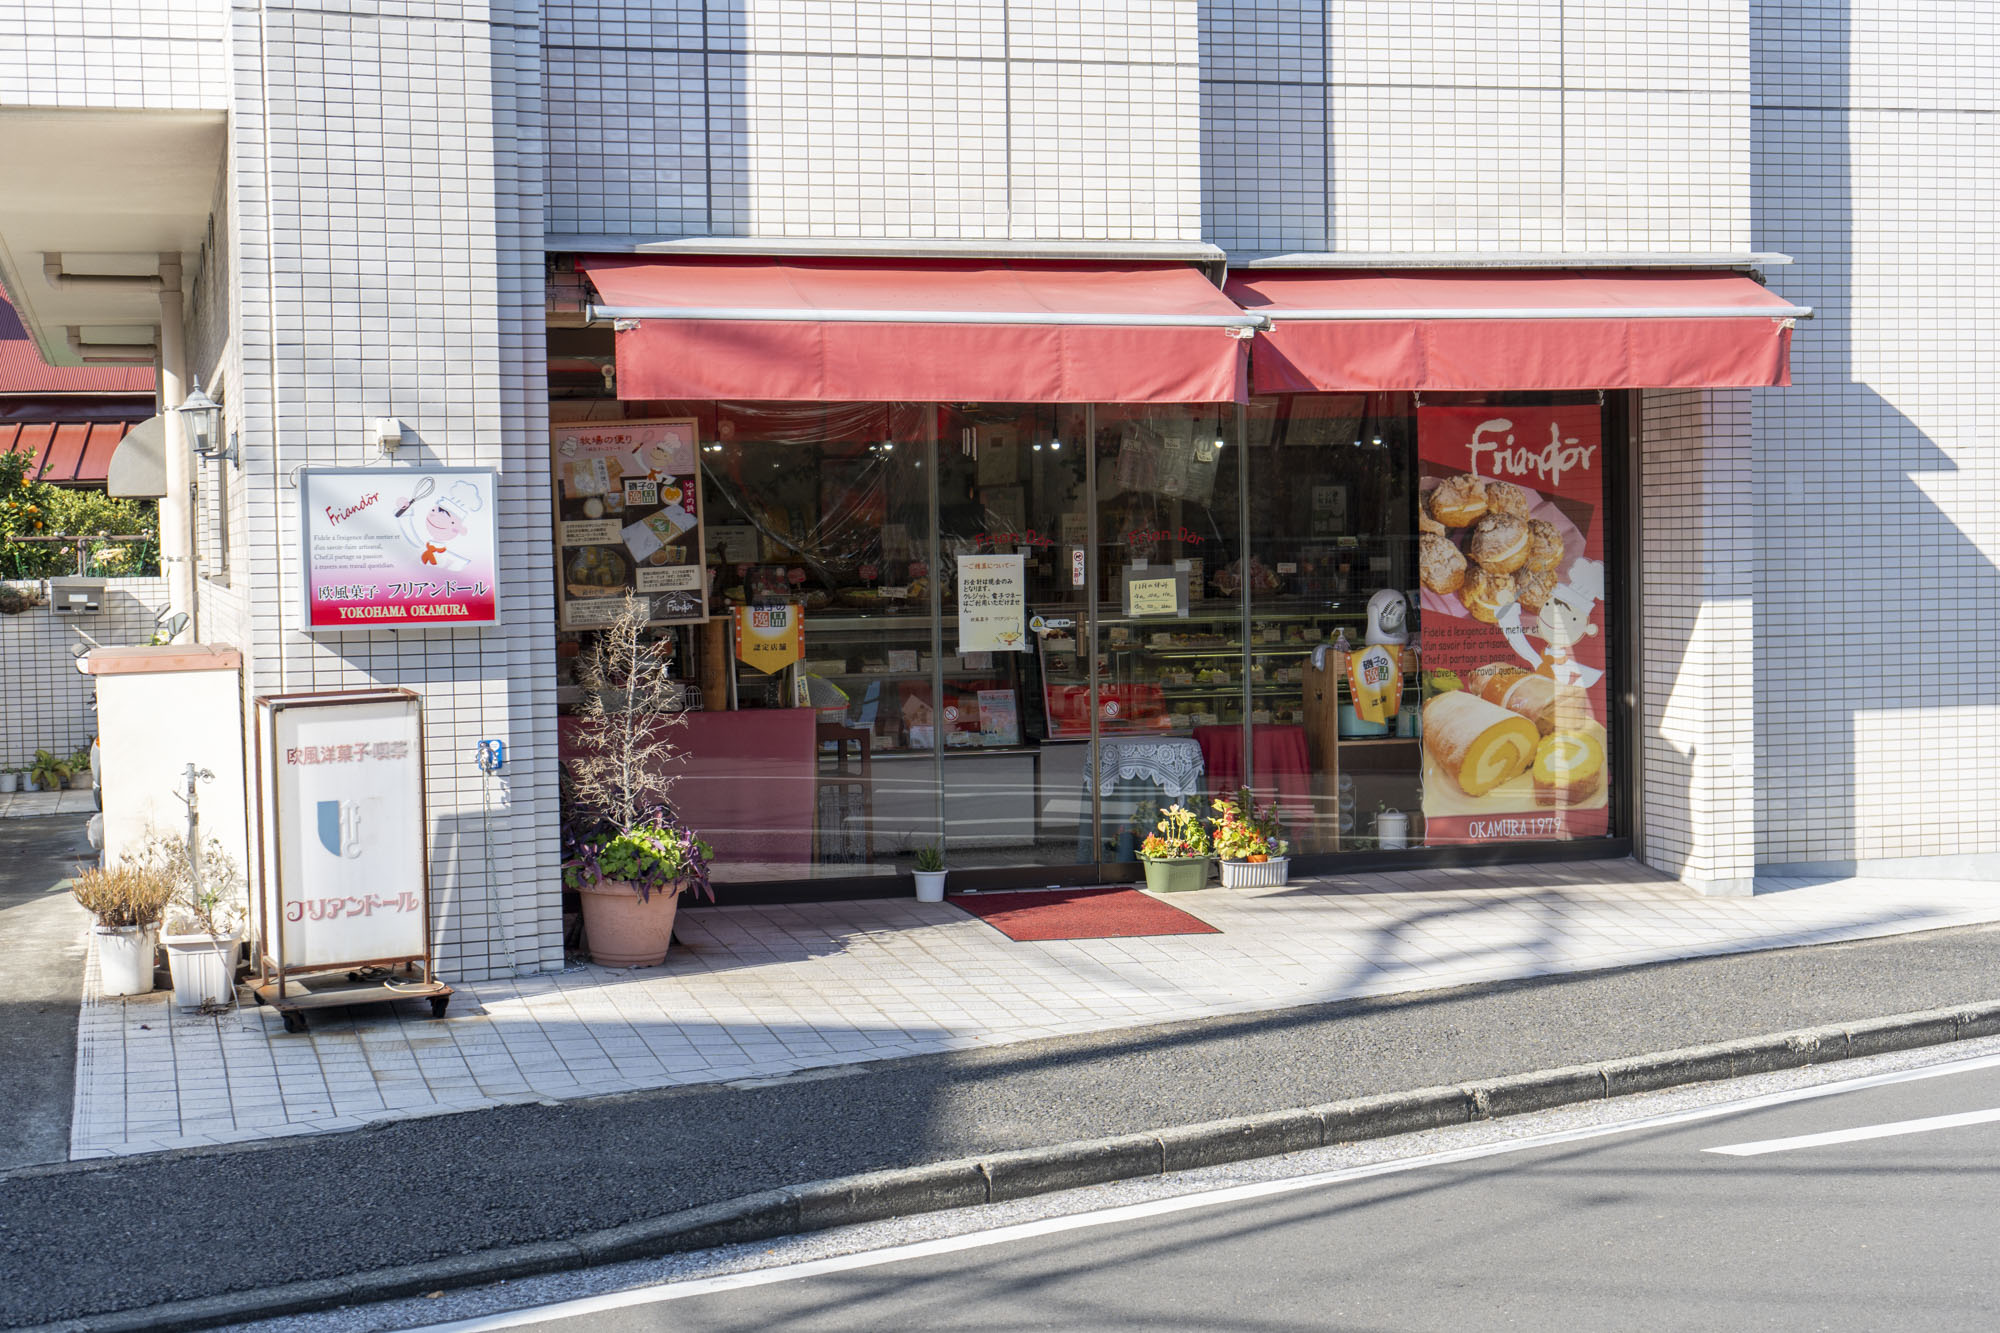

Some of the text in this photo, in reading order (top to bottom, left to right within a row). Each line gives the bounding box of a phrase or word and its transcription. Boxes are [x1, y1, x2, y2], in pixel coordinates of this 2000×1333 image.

[318, 580, 489, 600] 欧風菓子 フリアンドール
[963, 578, 1014, 586] お会計は現金のみ
[963, 585, 992, 593] となります。
[338, 603, 469, 619] YOKOHAMA OKAMURA
[753, 612, 787, 628] 逸品
[1469, 816, 1562, 839] OKAMURA 1979
[286, 891, 419, 923] フリアンドール
